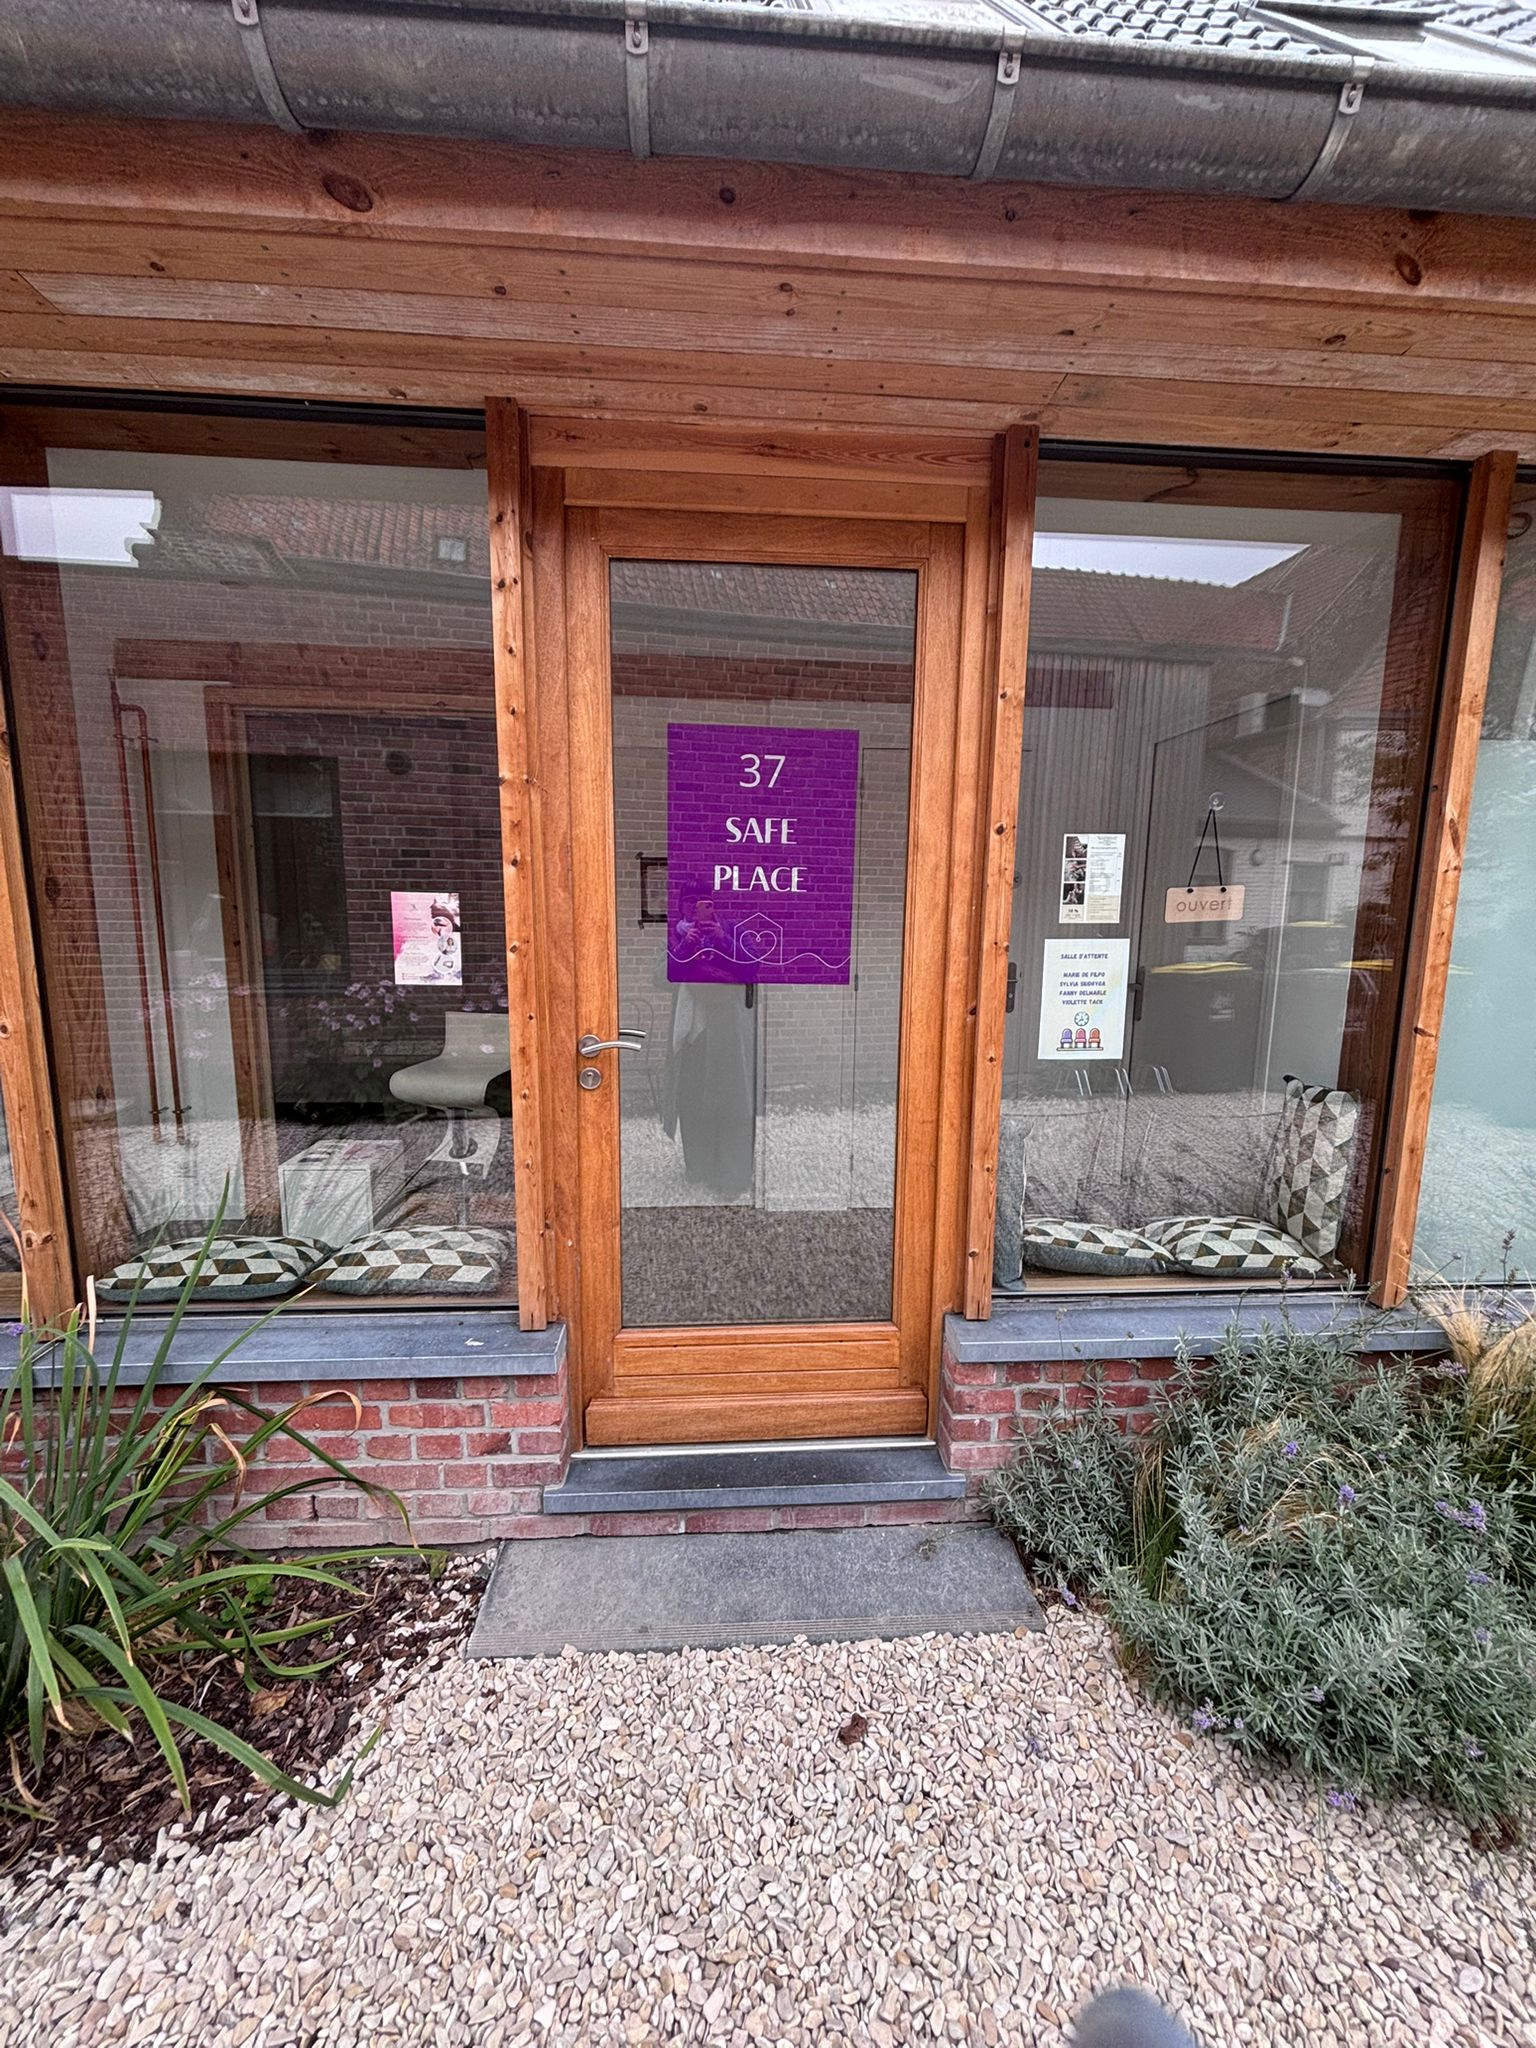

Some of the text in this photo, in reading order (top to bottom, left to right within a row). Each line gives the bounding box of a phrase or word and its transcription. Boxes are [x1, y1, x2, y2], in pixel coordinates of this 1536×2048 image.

[739, 753, 786, 788] 37
[725, 817, 798, 844] SAFE
[713, 865, 808, 892] PLACE
[1176, 896, 1232, 912] ouvert
